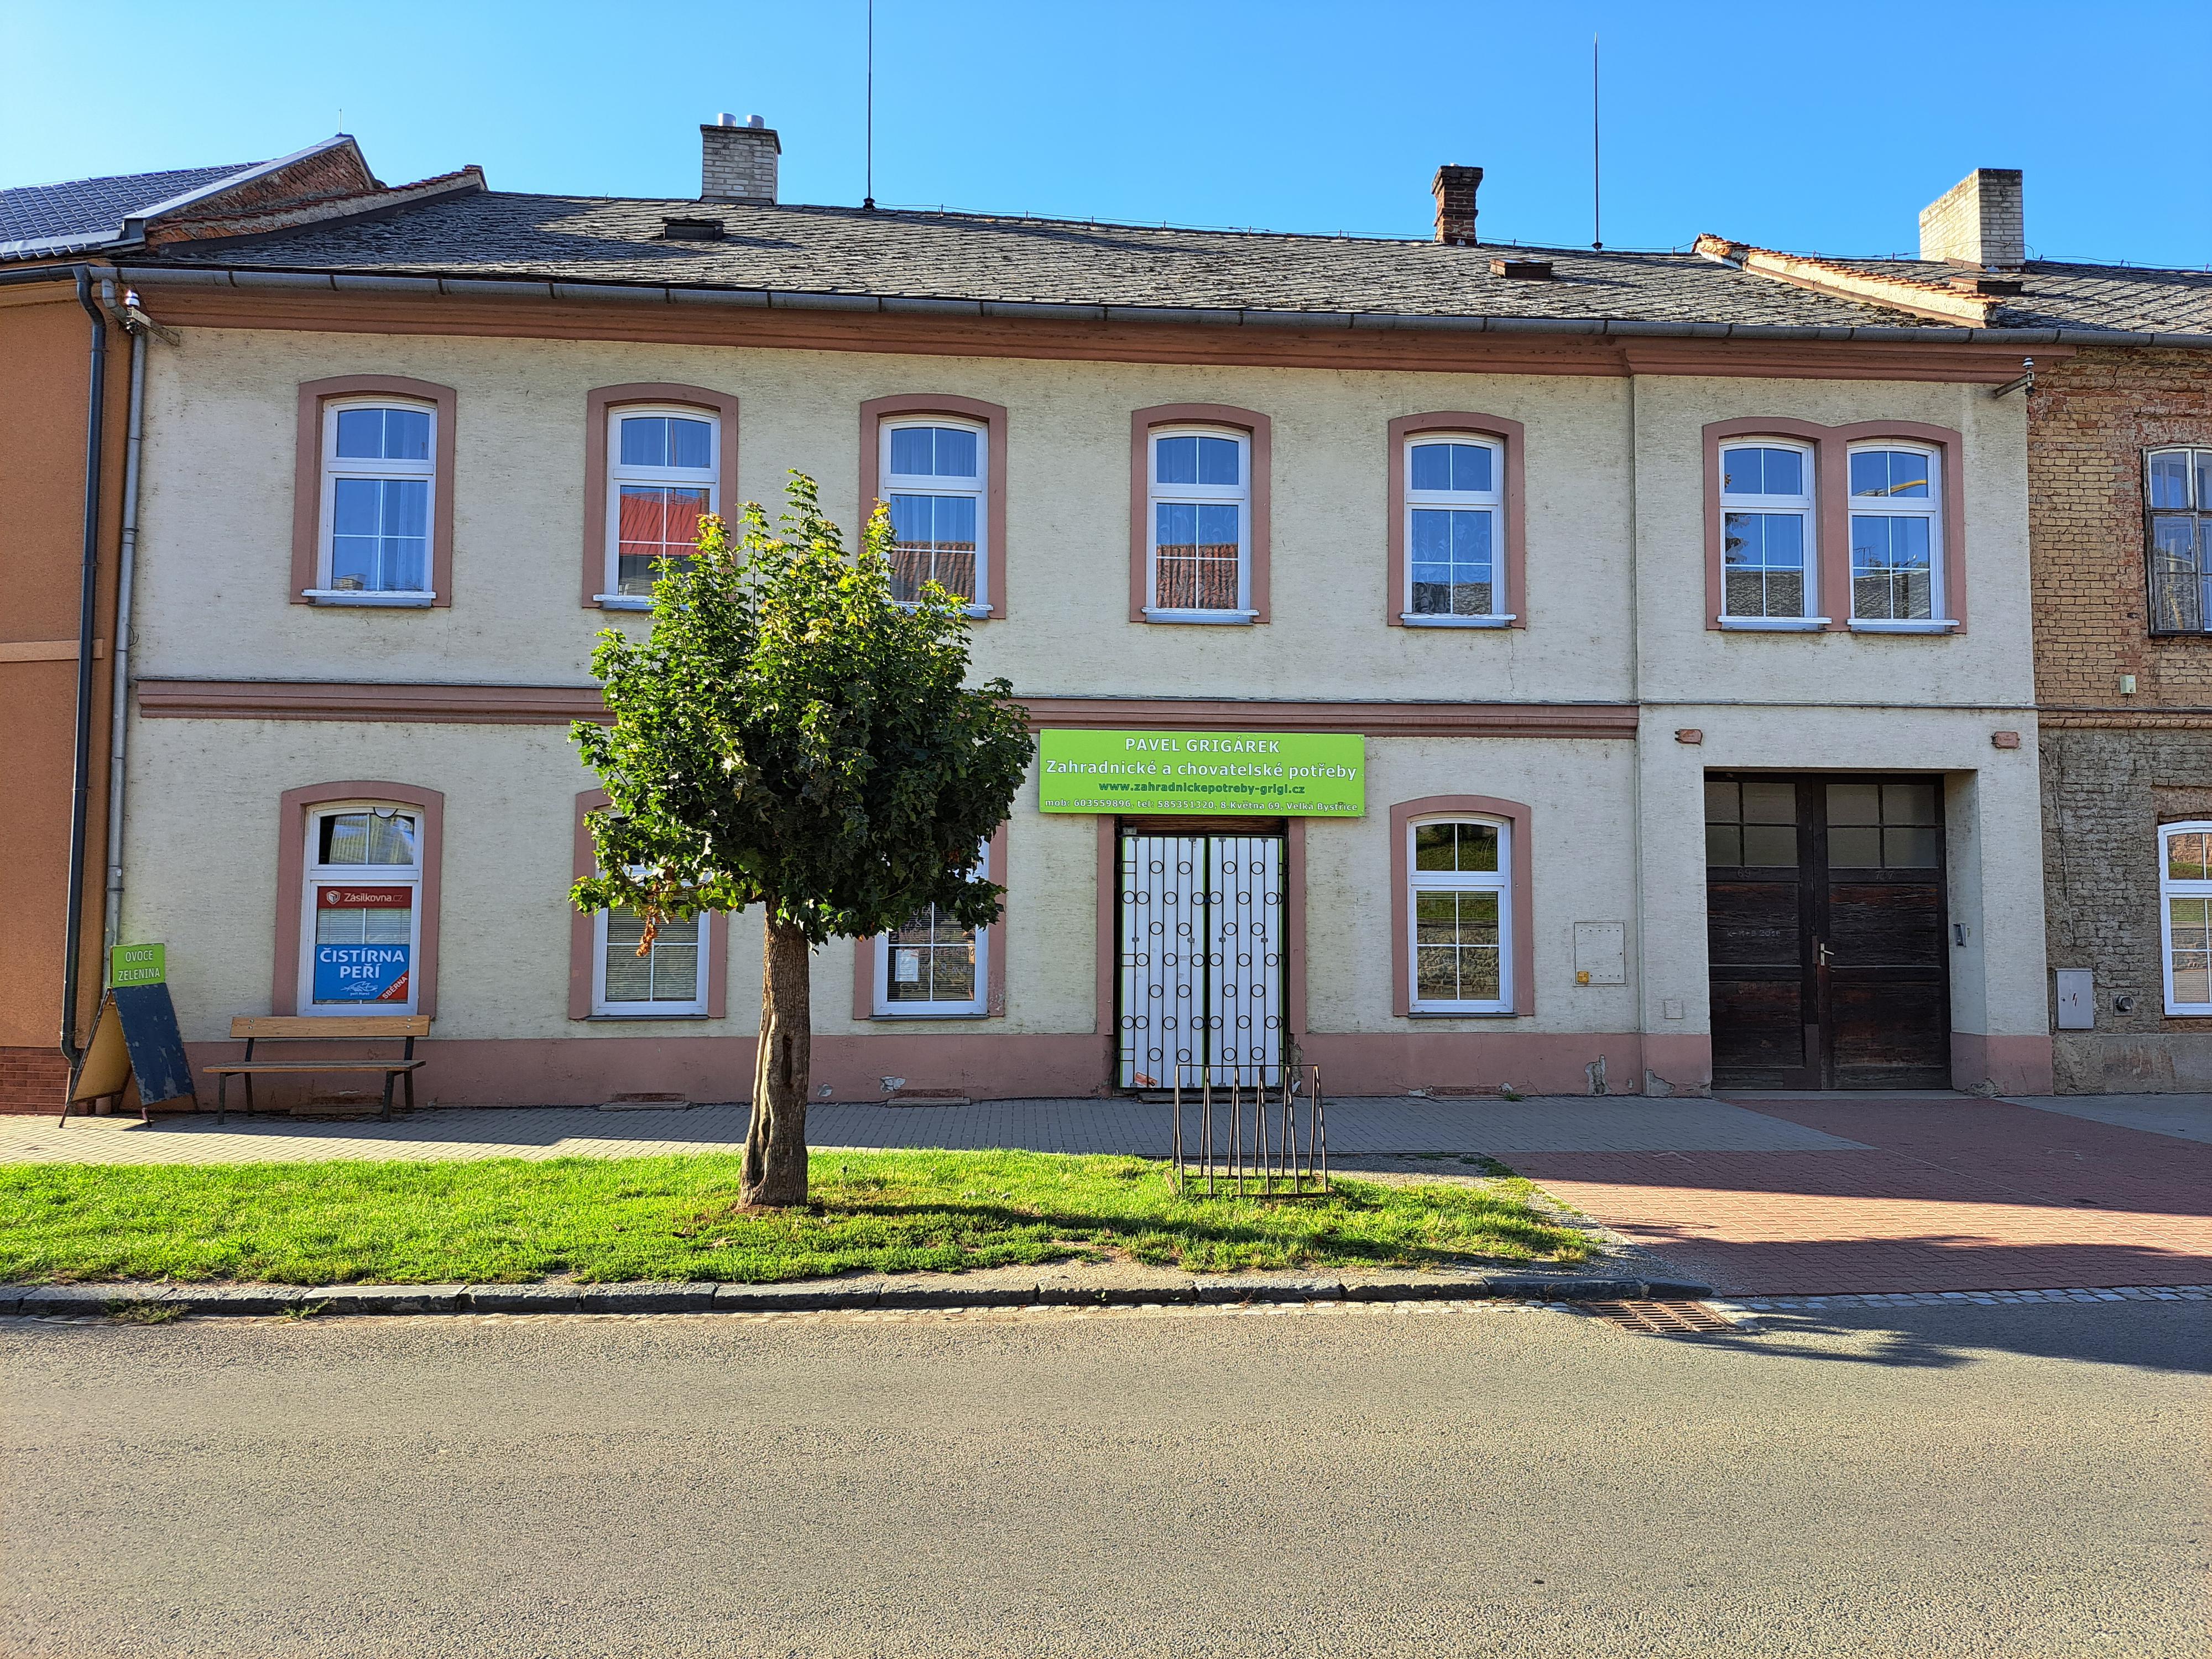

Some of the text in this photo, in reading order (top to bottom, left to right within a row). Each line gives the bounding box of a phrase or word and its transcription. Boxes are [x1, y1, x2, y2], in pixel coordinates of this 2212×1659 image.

[1125, 735, 1280, 753] PAVEL GRIGÁREK
[1046, 760, 1357, 780] Zahradnické a chovatelské potřeby
[1098, 782, 1305, 796] www.zahradnickepotreby-grigi.cz
[1074, 799, 1134, 808] 603559896,
[1137, 800, 1154, 808] tel:
[1157, 800, 1217, 811] 585351320,
[1268, 802, 1283, 811] 69,
[1286, 801, 1314, 810] Velká
[1317, 802, 1358, 812] Bystřice
[1738, 869, 1750, 878] 69
[344, 893, 403, 902] Zásilkovna.cz
[126, 950, 154, 962] OVOCE
[320, 947, 405, 962] ČISTÍRNA
[118, 967, 160, 981] ZELENINA
[340, 963, 382, 978] PEŘÍ
[382, 976, 408, 999] SBĚRNA
